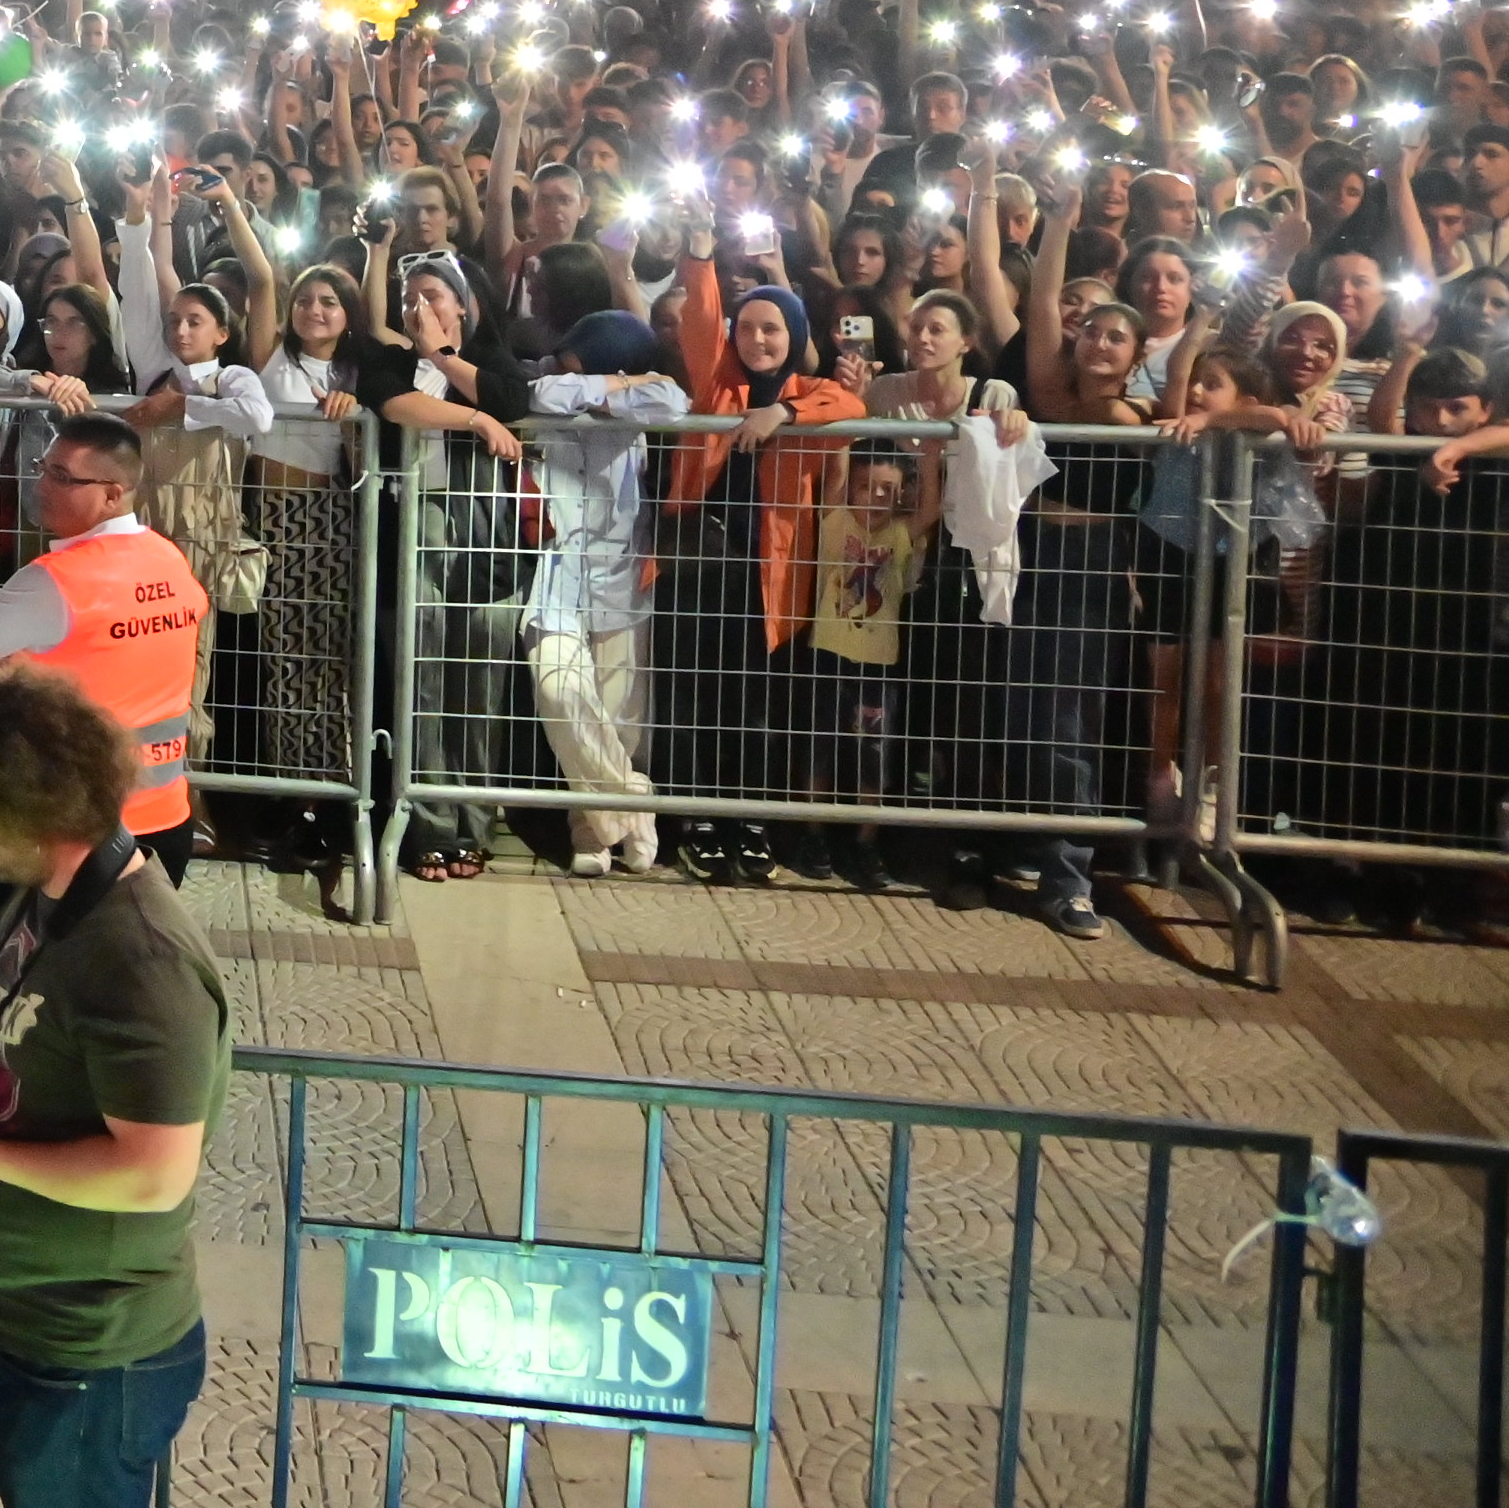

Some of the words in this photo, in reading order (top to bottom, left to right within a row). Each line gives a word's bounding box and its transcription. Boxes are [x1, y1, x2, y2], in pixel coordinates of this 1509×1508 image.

[134, 580, 176, 604] ÖZEL
[109, 606, 197, 640] GÜVENLİK
[569, 1388, 687, 1413] TURGUTLU
